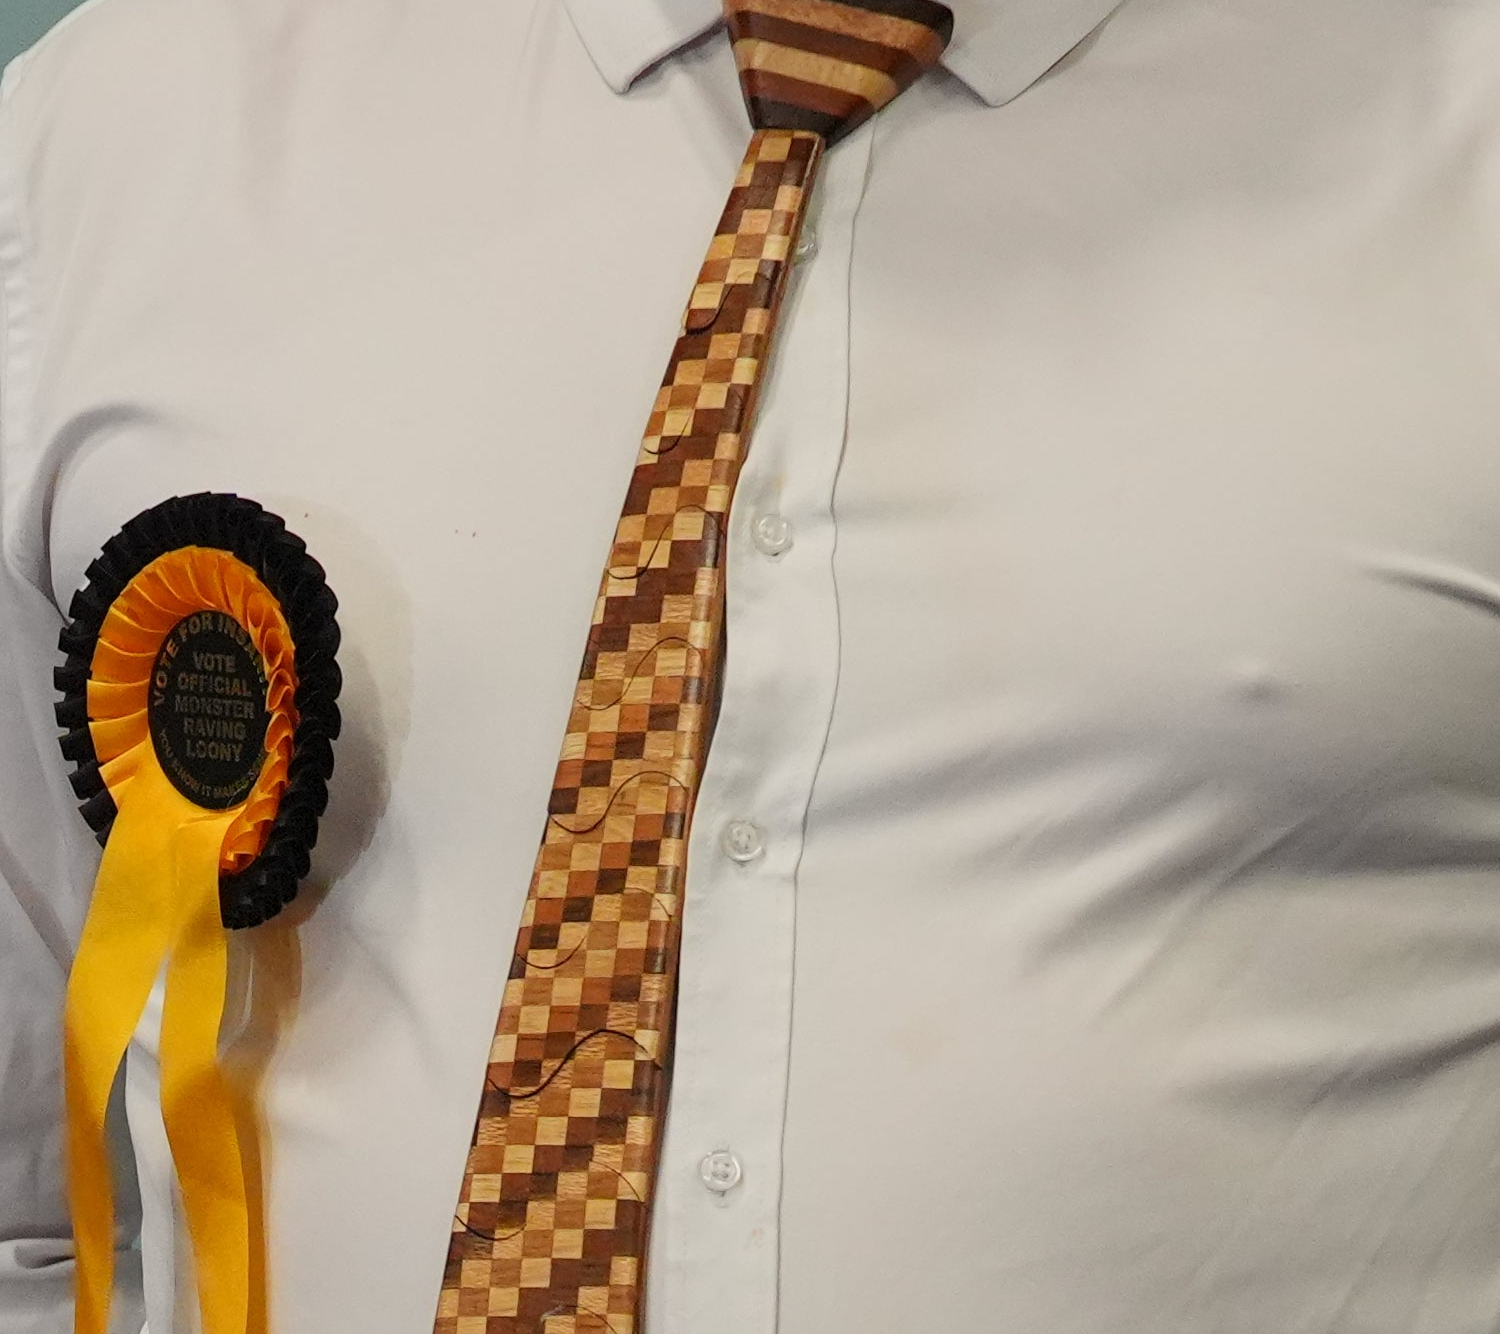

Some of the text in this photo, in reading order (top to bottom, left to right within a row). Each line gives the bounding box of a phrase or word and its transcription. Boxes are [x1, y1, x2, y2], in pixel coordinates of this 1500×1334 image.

[153, 638, 179, 707] VOTE
[178, 611, 214, 643] FOR
[192, 652, 237, 673] VOTE
[177, 671, 252, 697] OFFICIAL
[174, 693, 255, 720] MONSTER
[183, 717, 247, 741] RAVING
[186, 739, 244, 763] LOONY
